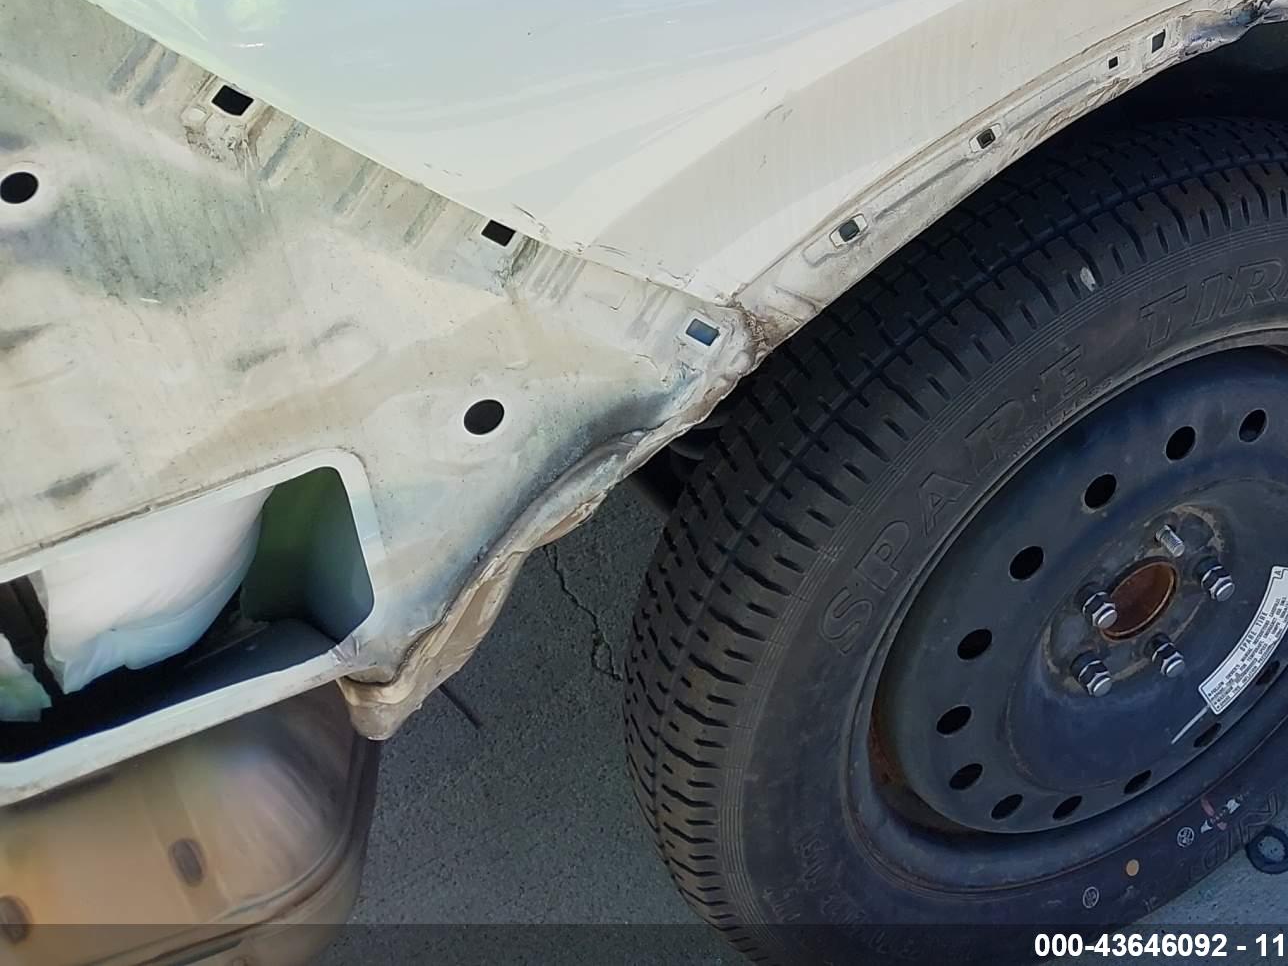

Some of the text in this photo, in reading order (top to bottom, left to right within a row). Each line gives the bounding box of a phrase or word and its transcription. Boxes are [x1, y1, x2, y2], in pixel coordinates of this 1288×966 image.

[819, 344, 1088, 656] SPARE
[1240, 631, 1257, 651] SPARE
[1256, 611, 1268, 626] TIRE
